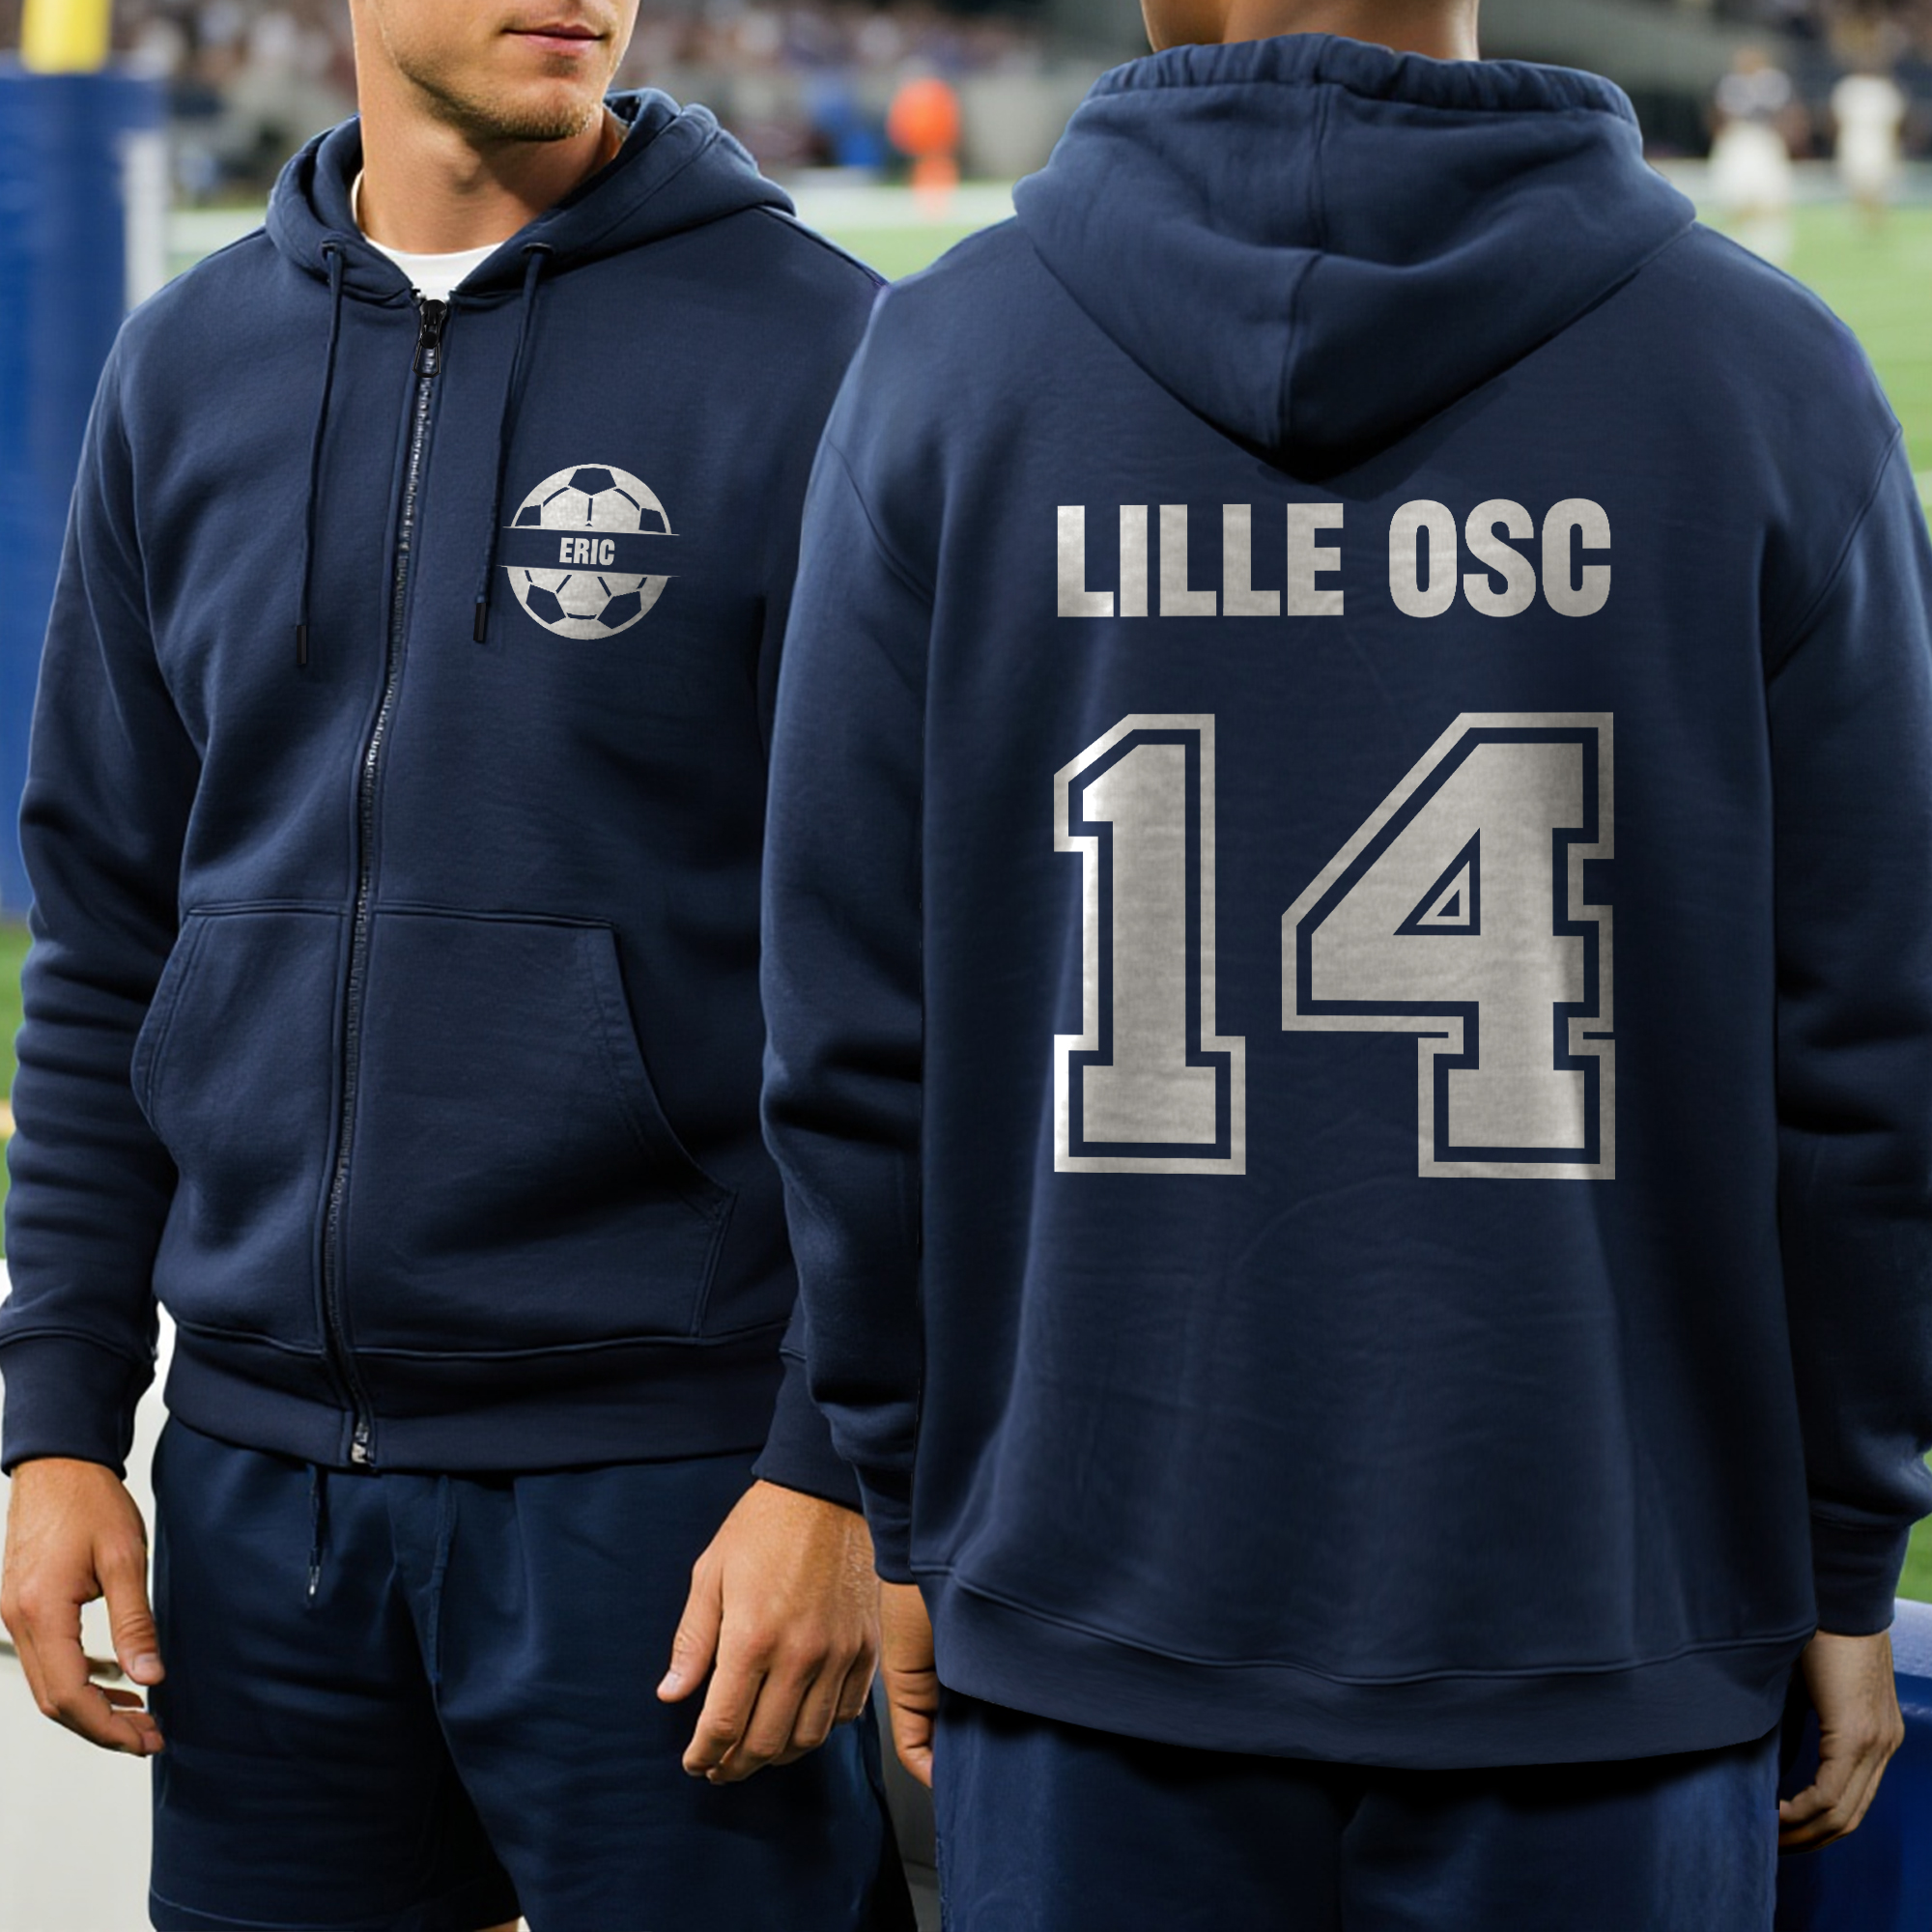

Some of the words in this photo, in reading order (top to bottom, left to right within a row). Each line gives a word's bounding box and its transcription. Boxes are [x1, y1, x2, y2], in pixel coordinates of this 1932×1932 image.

[558, 536, 615, 566] ERIC
[1056, 501, 1345, 618] LILLE
[1387, 497, 1612, 618] OSC
[1053, 712, 1616, 1180] 14
